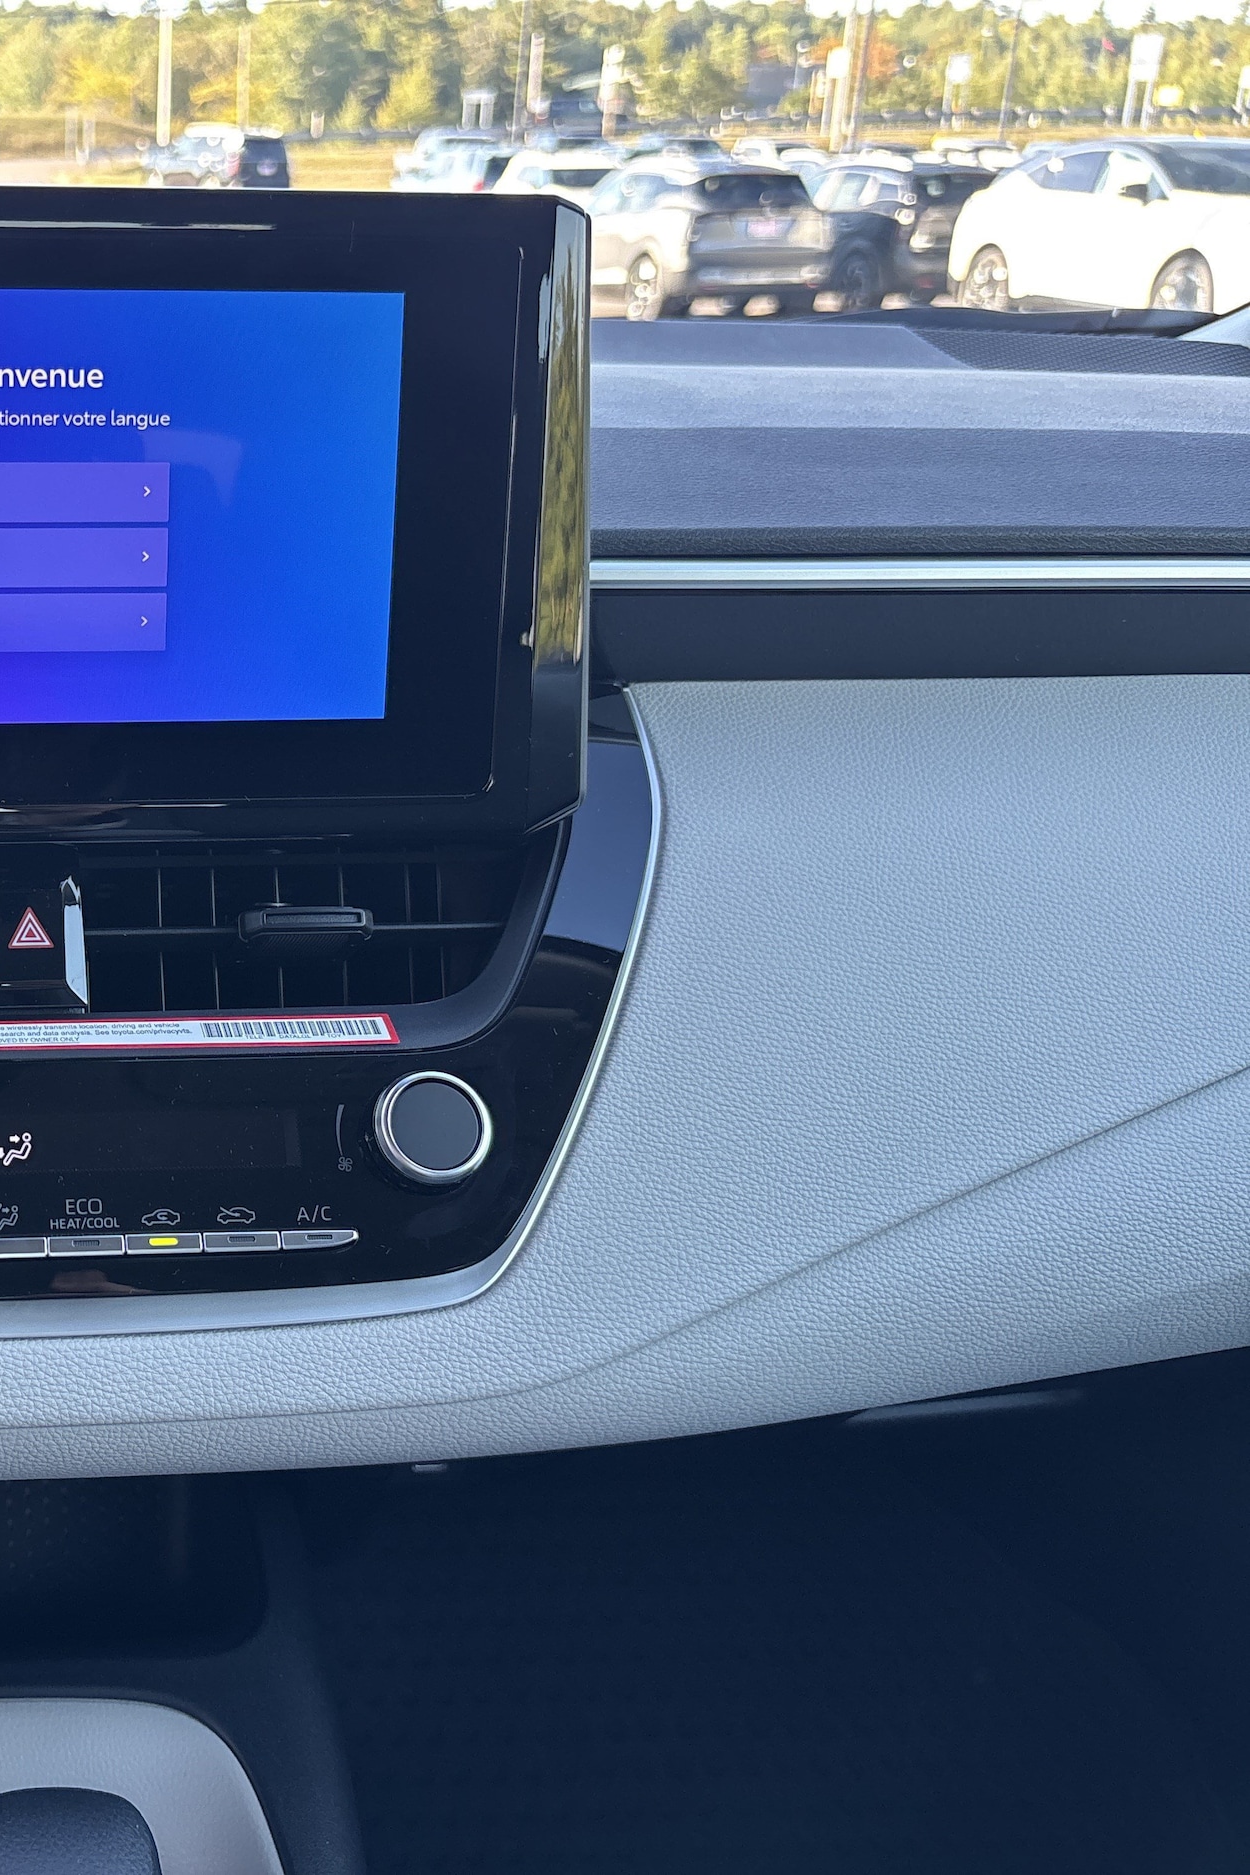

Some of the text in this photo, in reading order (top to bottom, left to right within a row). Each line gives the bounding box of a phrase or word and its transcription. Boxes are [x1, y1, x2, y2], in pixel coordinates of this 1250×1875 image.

[63, 411, 106, 427] votre
[110, 409, 170, 430] langue
[65, 1198, 102, 1215] ECO
[297, 1205, 332, 1223] A/C
[50, 1216, 120, 1229] HEAT/COOL
